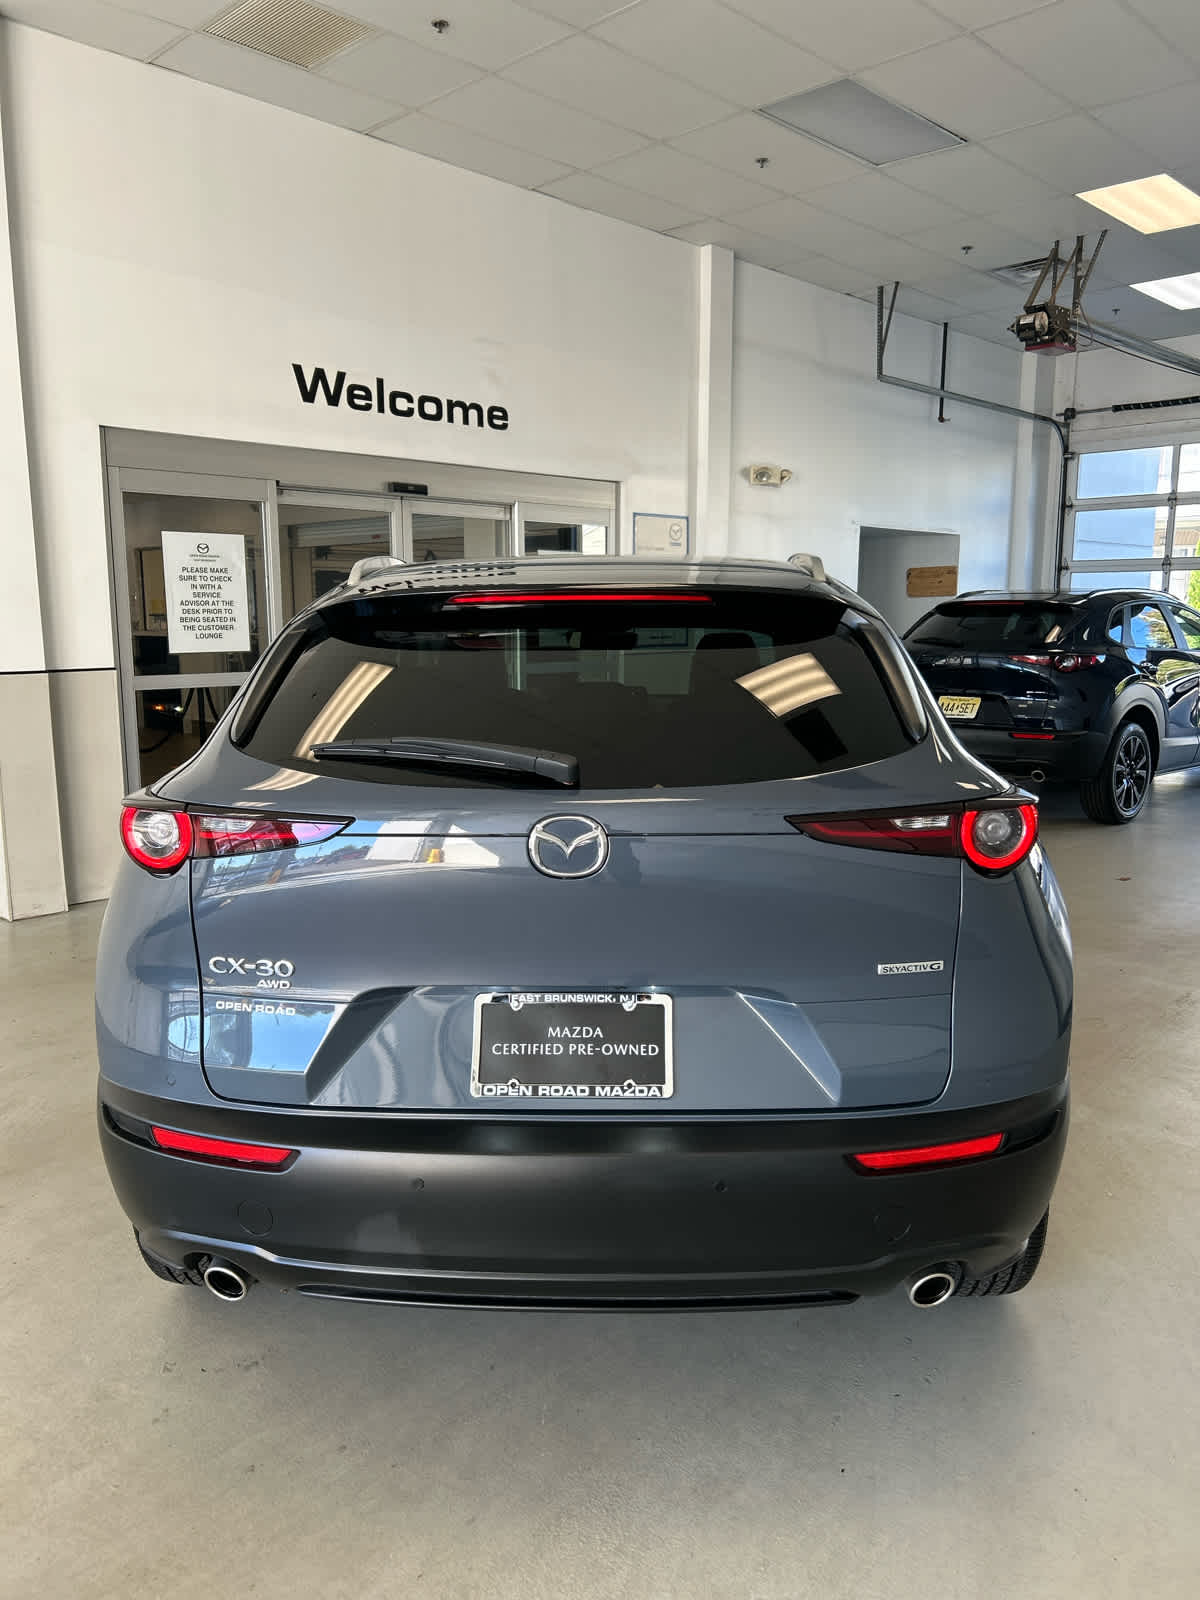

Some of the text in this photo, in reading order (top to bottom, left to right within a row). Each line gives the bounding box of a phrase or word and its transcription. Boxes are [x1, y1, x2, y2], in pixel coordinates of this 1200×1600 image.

[292, 363, 508, 430] Welcome
[181, 566, 208, 574] PLEASE
[180, 599, 210, 607] ADVISOR
[208, 956, 294, 978] CX-30
[257, 979, 291, 990] AWD
[544, 994, 616, 1004] BRUNSWICK,
[215, 1000, 296, 1017] OPEN ROAD
[547, 1026, 604, 1039] MAZDA
[491, 1043, 660, 1056] CERTIFIED PRE-OWNED
[483, 1085, 662, 1098] OPEN ROAD MAZDA
